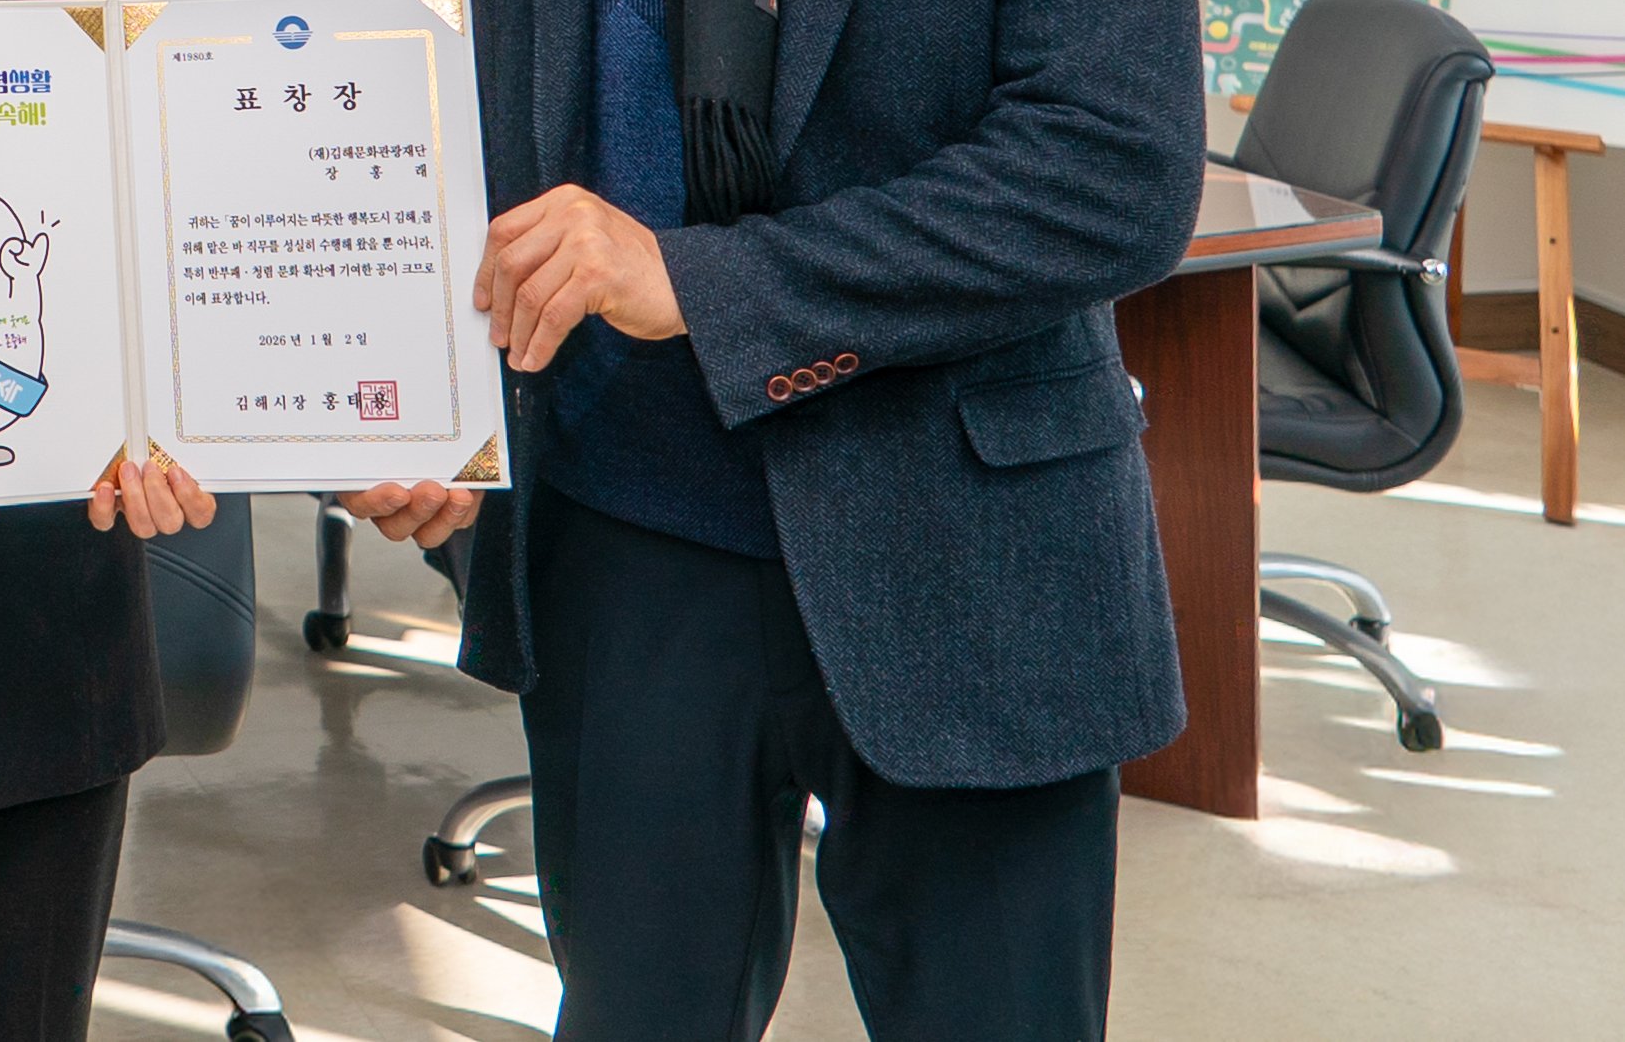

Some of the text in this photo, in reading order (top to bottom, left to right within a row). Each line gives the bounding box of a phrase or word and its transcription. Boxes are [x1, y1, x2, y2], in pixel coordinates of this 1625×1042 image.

[173, 51, 214, 62] 제1980호
[308, 143, 427, 162] (재)김해문화관광재단
[188, 215, 221, 230] 귀하는
[254, 213, 309, 228] 이루어지는
[311, 212, 343, 226] 따뜻한
[347, 210, 391, 226] 행복도시
[183, 241, 203, 255] 위해
[231, 240, 243, 254] 바
[247, 240, 279, 254] 직무를
[283, 238, 315, 253] 성실히
[319, 238, 353, 252] 수행해
[356, 236, 378, 251] 왔을
[381, 236, 393, 250] 뿐
[183, 262, 435, 280] 특히 반부패 청렴 문화 확산에 기여한 공이 크므로
[185, 290, 270, 306] 이에 표창합니다.
